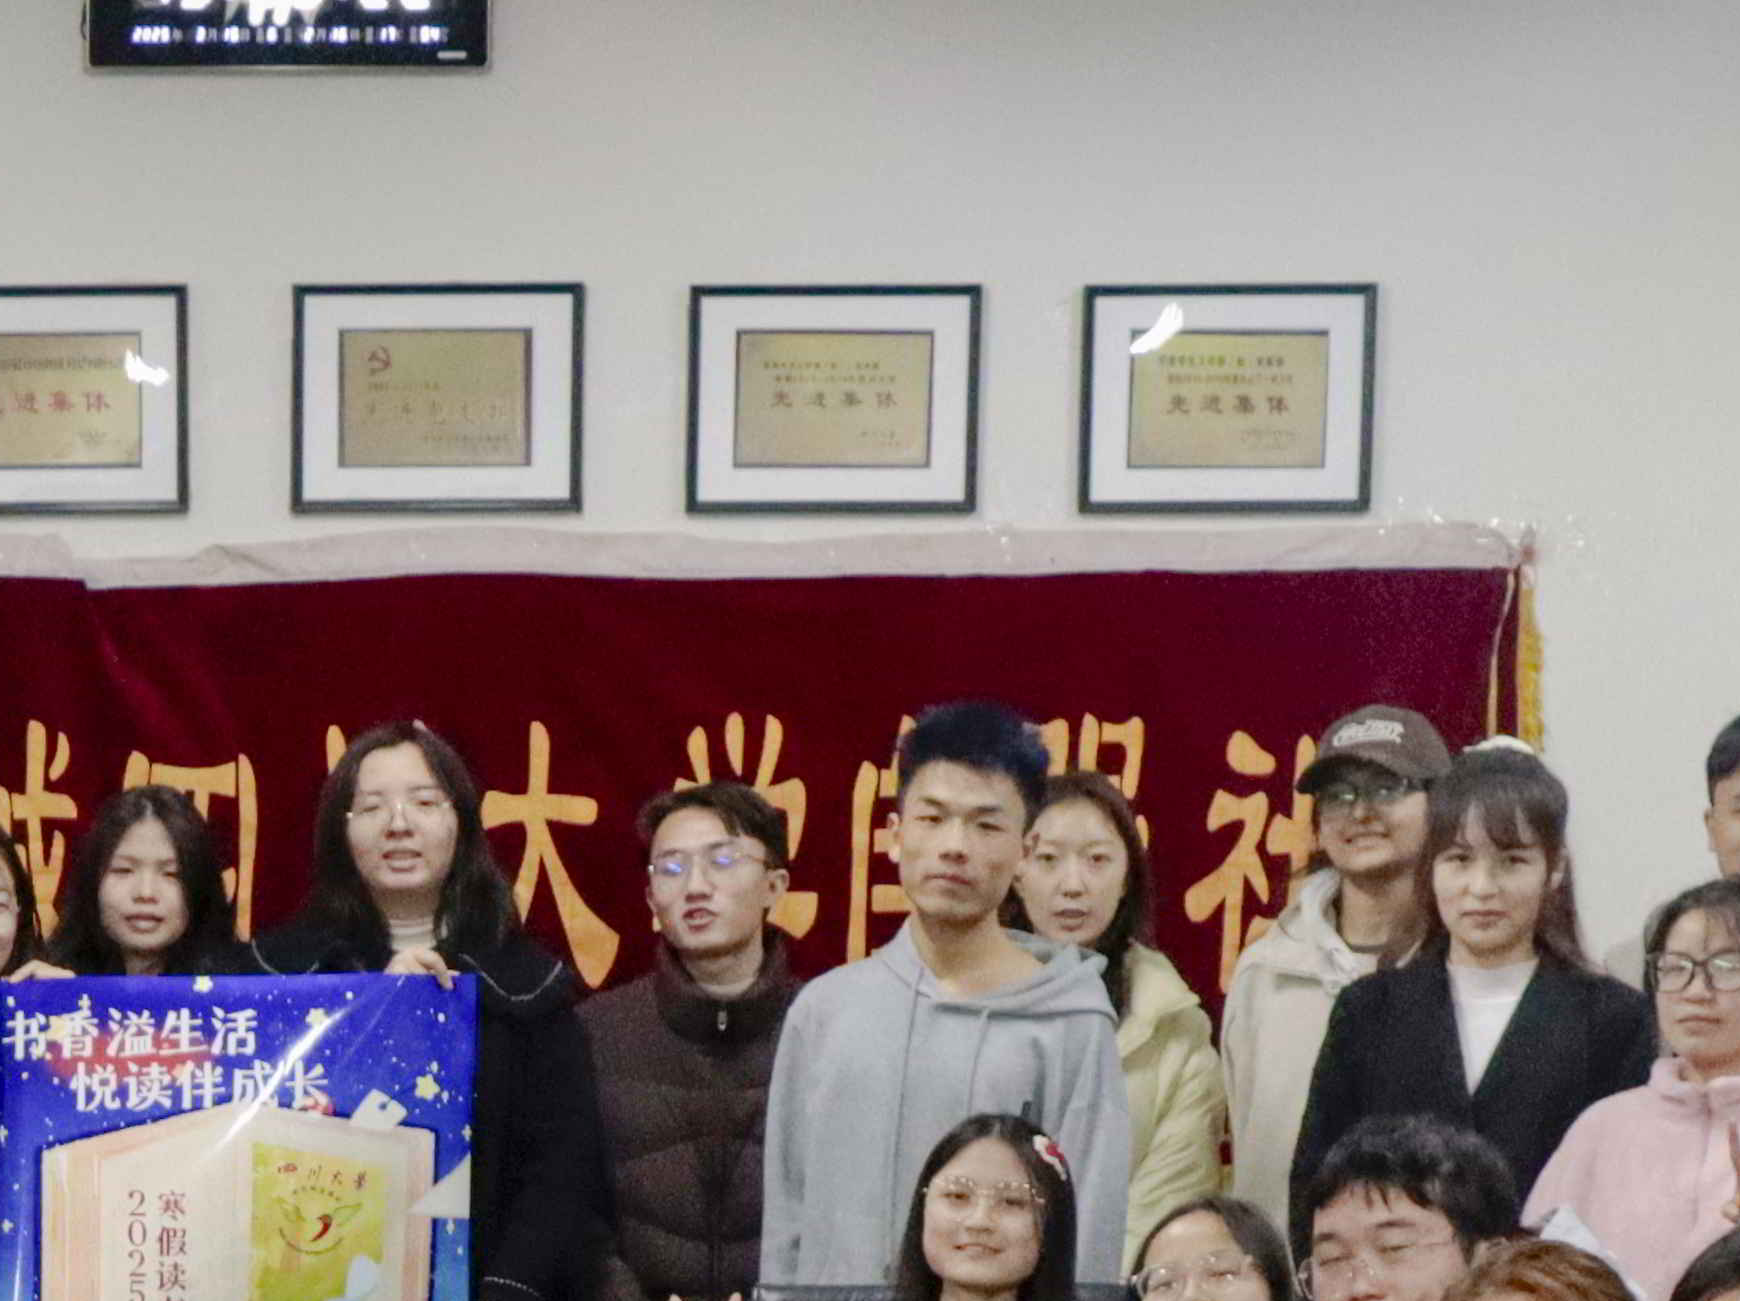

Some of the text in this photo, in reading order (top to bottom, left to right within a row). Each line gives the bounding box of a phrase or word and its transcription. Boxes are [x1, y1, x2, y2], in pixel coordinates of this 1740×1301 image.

[770, 391, 898, 410] 先进集体
[1167, 393, 1290, 416] 先进集体
[1, 1006, 259, 1061] 书香溢生活
[71, 1061, 329, 1112] 悦读伴成长
